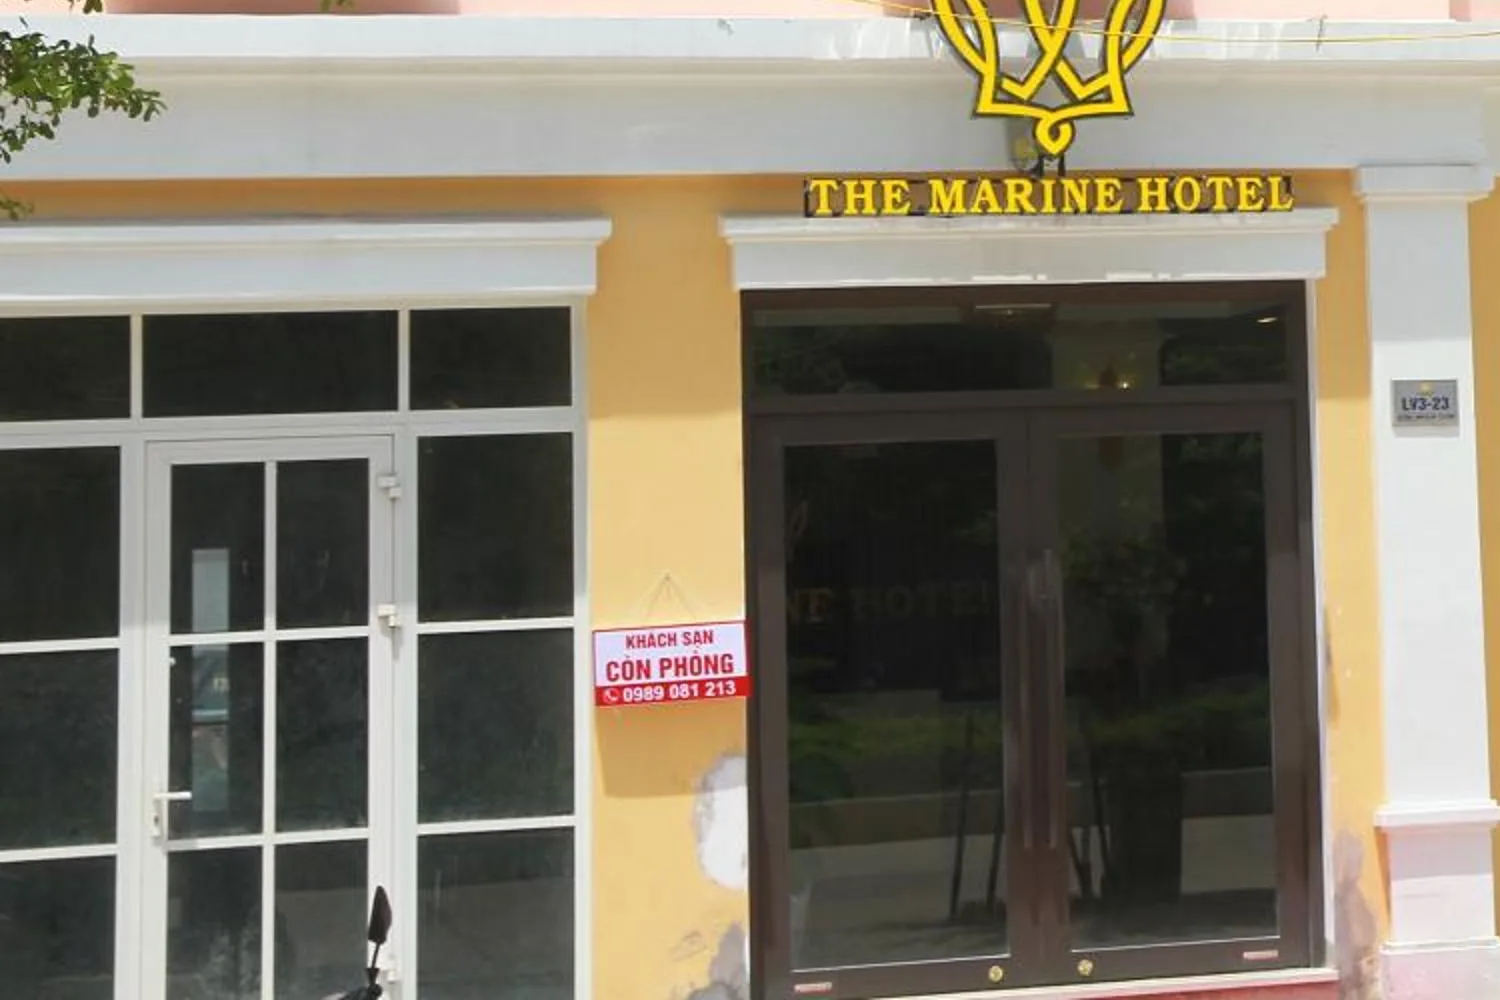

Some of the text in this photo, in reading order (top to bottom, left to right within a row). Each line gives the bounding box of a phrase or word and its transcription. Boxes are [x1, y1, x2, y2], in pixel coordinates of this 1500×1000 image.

[809, 176, 1293, 214] THE MARINE HOTEL
[1401, 396, 1449, 411] LV3-23
[606, 649, 734, 682] CÒN PHÒNG
[623, 679, 737, 703] 0989 081 213
